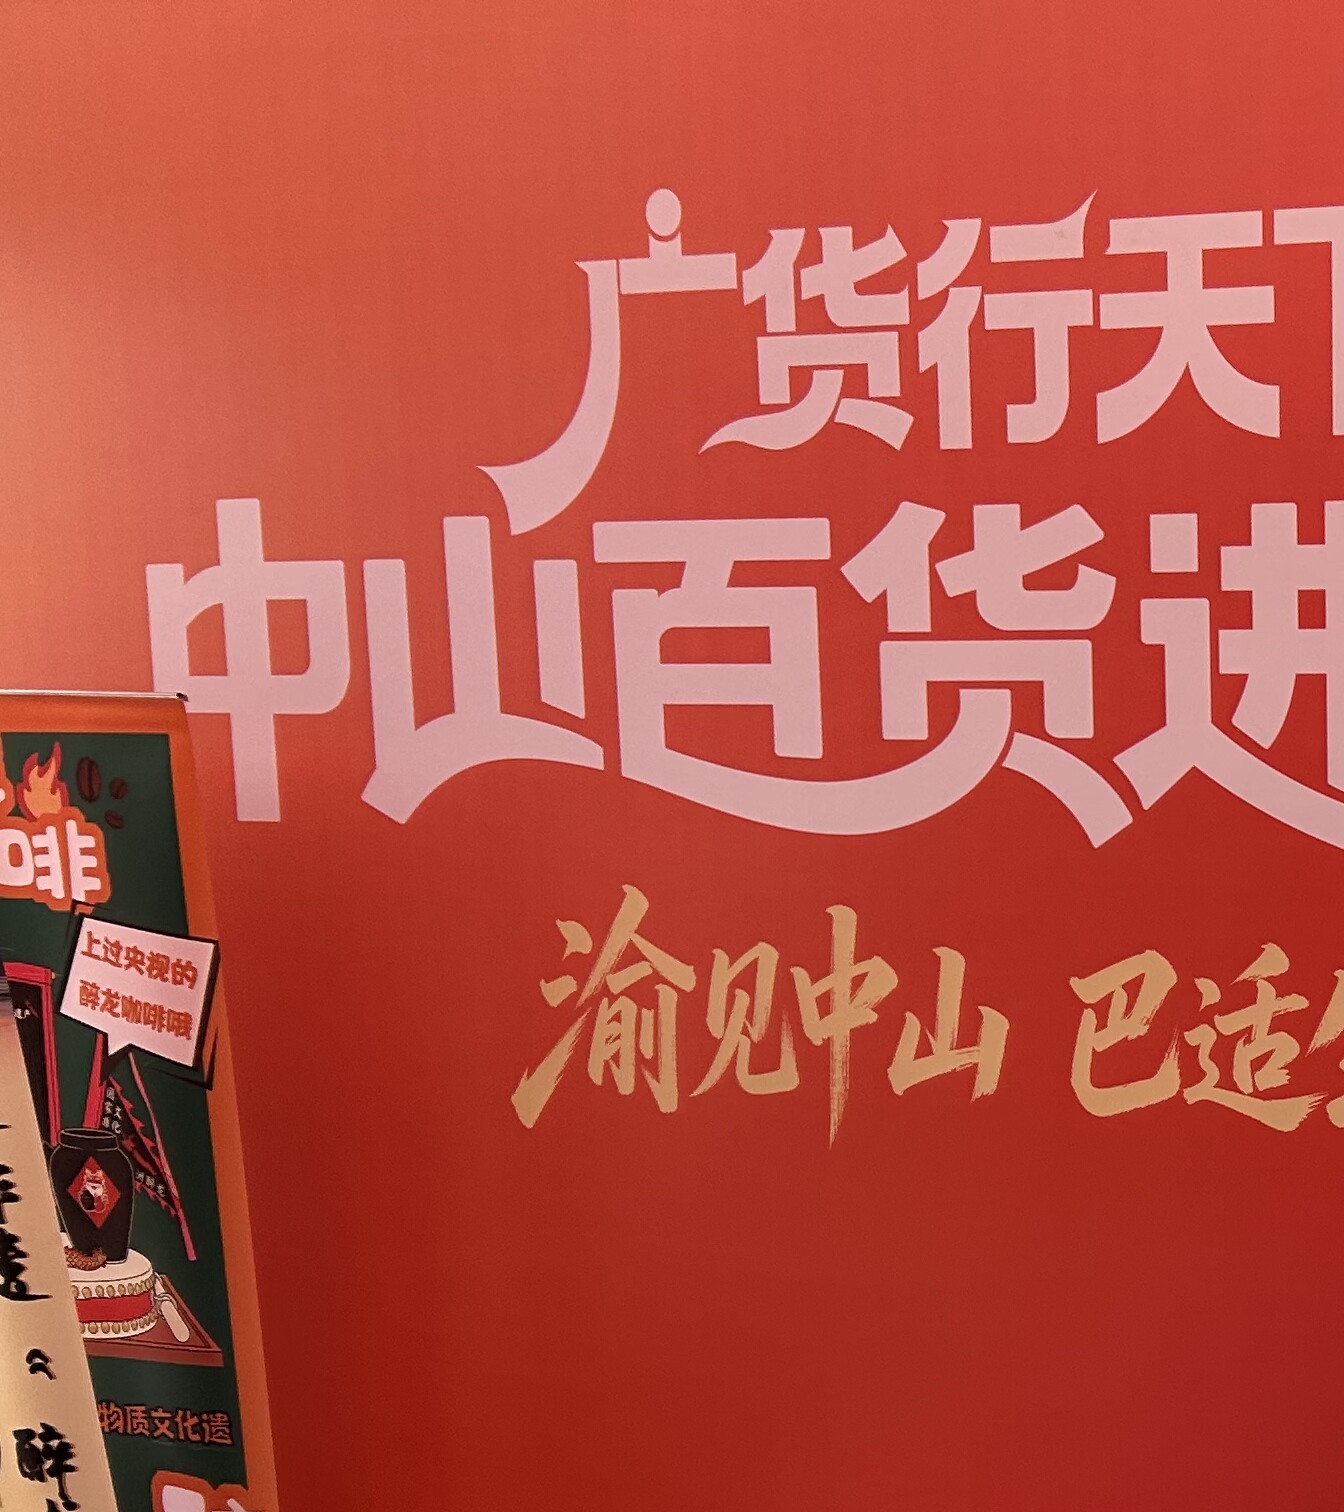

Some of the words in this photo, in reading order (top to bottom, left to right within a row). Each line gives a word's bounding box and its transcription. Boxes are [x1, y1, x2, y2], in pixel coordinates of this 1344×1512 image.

[81, 931, 198, 990] 上过央视的
[511, 886, 1010, 1144] 渝见中山
